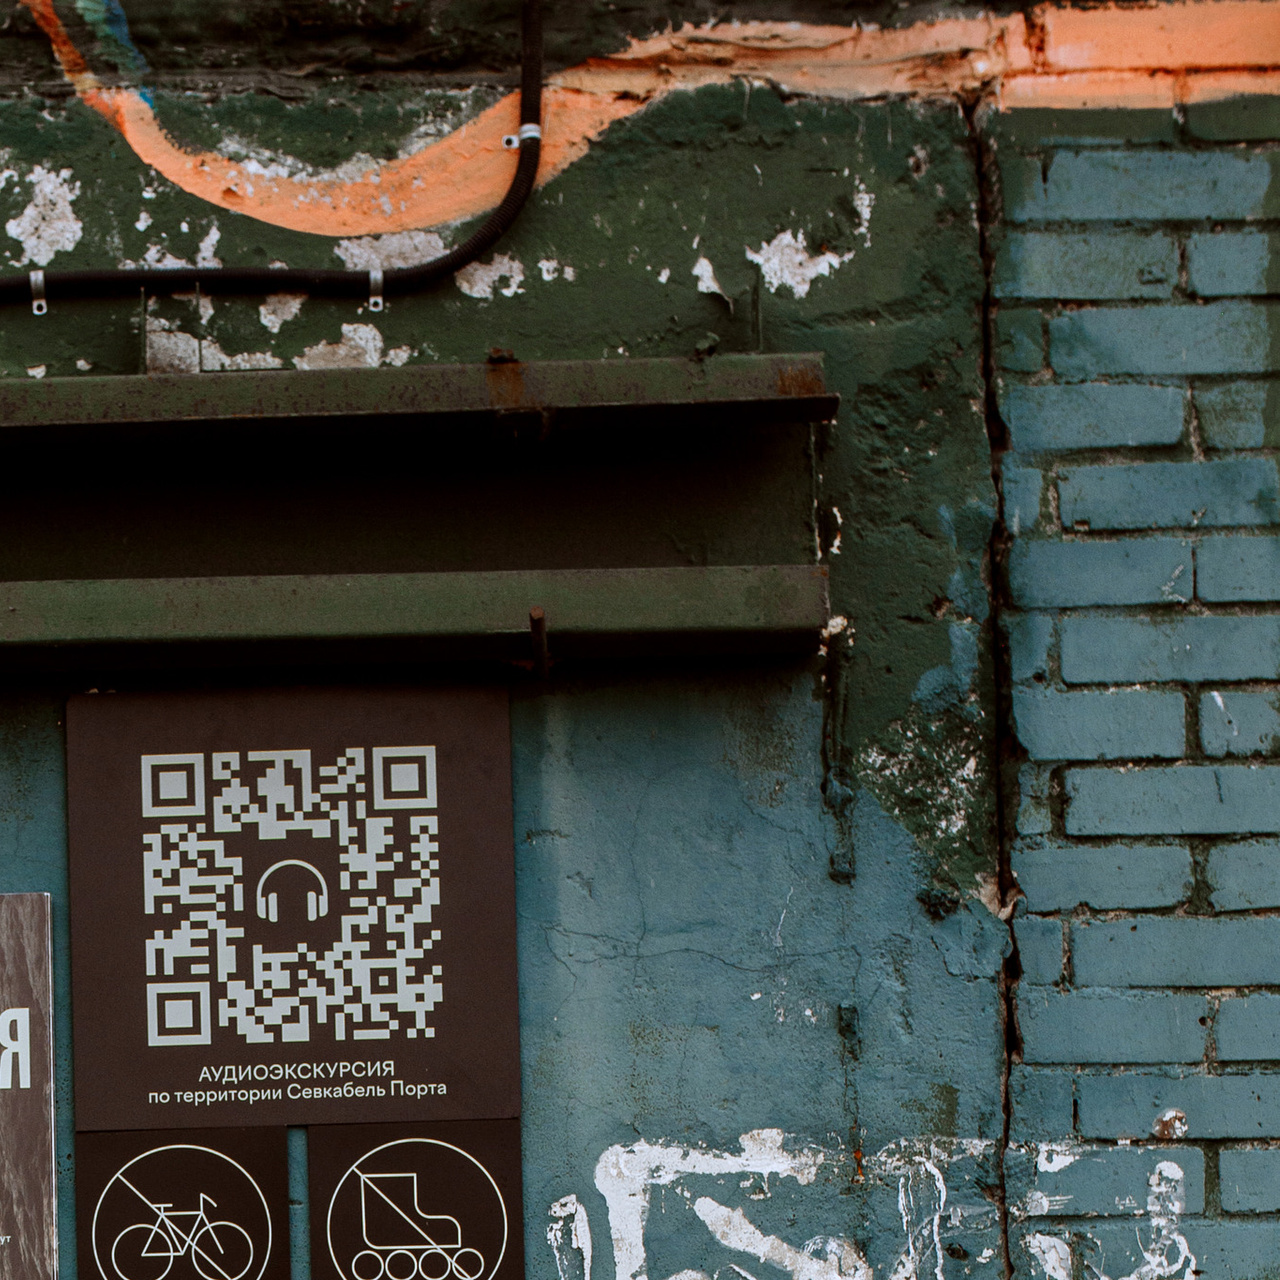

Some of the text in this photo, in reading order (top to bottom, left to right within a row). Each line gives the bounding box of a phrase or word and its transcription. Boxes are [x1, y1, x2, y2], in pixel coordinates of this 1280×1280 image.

[198, 1060, 395, 1085] АУДИОЭКСКУРСИЯ
[148, 1080, 447, 1106] по территории Севкабель Порта
